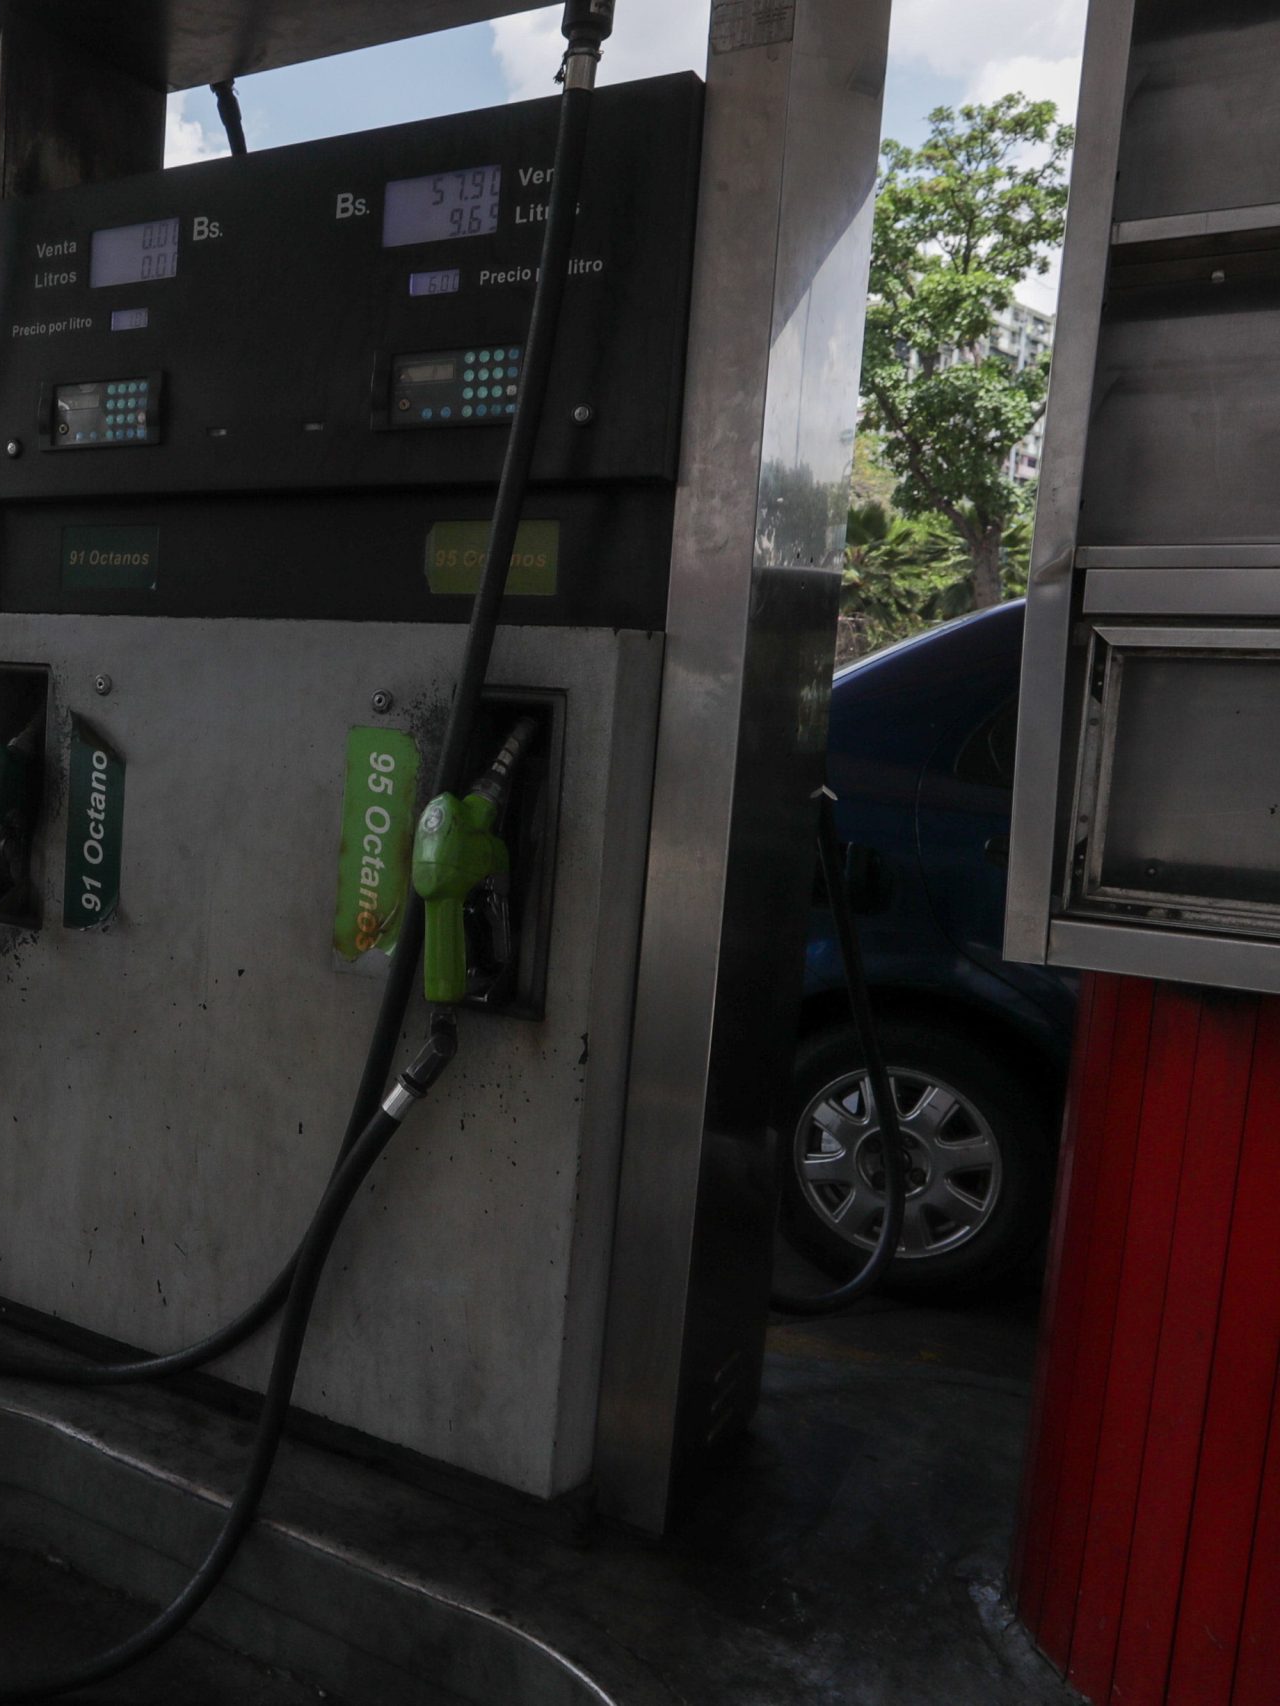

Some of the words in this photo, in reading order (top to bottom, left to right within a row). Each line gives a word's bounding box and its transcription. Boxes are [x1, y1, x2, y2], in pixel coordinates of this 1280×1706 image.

[336, 192, 370, 219] Bs.
[193, 216, 223, 241] Bs.
[36, 240, 77, 259] Venta
[34, 271, 77, 289] Litros
[479, 265, 531, 285] Precio
[568, 258, 603, 275] litro
[12, 320, 47, 337] Precio
[48, 319, 68, 336] por
[69, 317, 92, 331] litro
[69, 550, 86, 566] 91
[89, 550, 150, 566] Octanos
[435, 549, 458, 567] 95
[463, 549, 547, 568] Ocnos
[368, 751, 395, 795] 95
[83, 750, 108, 865] Octano
[81, 874, 102, 912] 91
